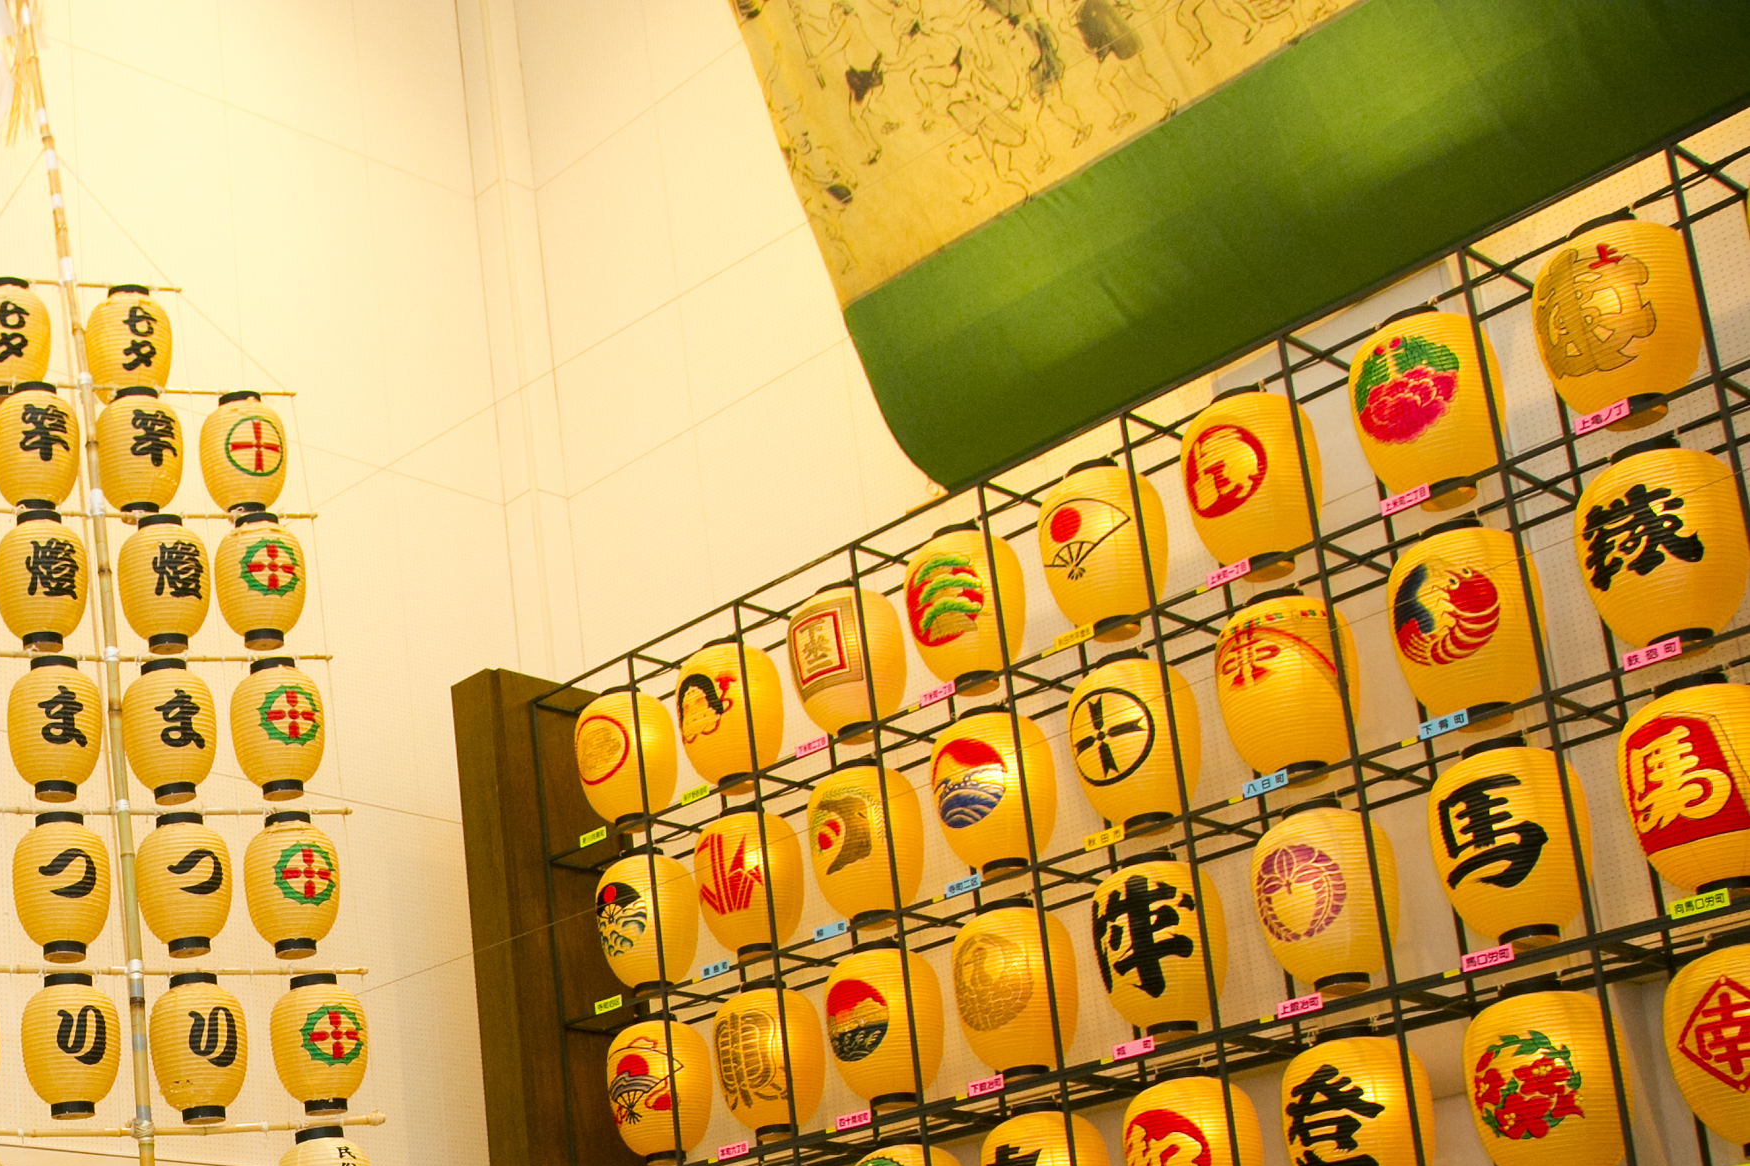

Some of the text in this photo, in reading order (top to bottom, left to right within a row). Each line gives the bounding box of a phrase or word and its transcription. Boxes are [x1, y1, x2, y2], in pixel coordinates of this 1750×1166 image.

[123, 307, 156, 370] 七夕
[38, 686, 87, 747] ま
[155, 690, 205, 748] ま
[1246, 773, 1285, 794] 八日町
[1088, 829, 1122, 847] 秋田市
[1439, 774, 1548, 889] 馬
[39, 849, 96, 898] つ
[168, 850, 222, 894] つ
[1674, 893, 1726, 915] 向馬口労町
[1466, 948, 1510, 968] 馬口労町
[57, 1006, 106, 1065] り
[189, 1007, 237, 1067] り
